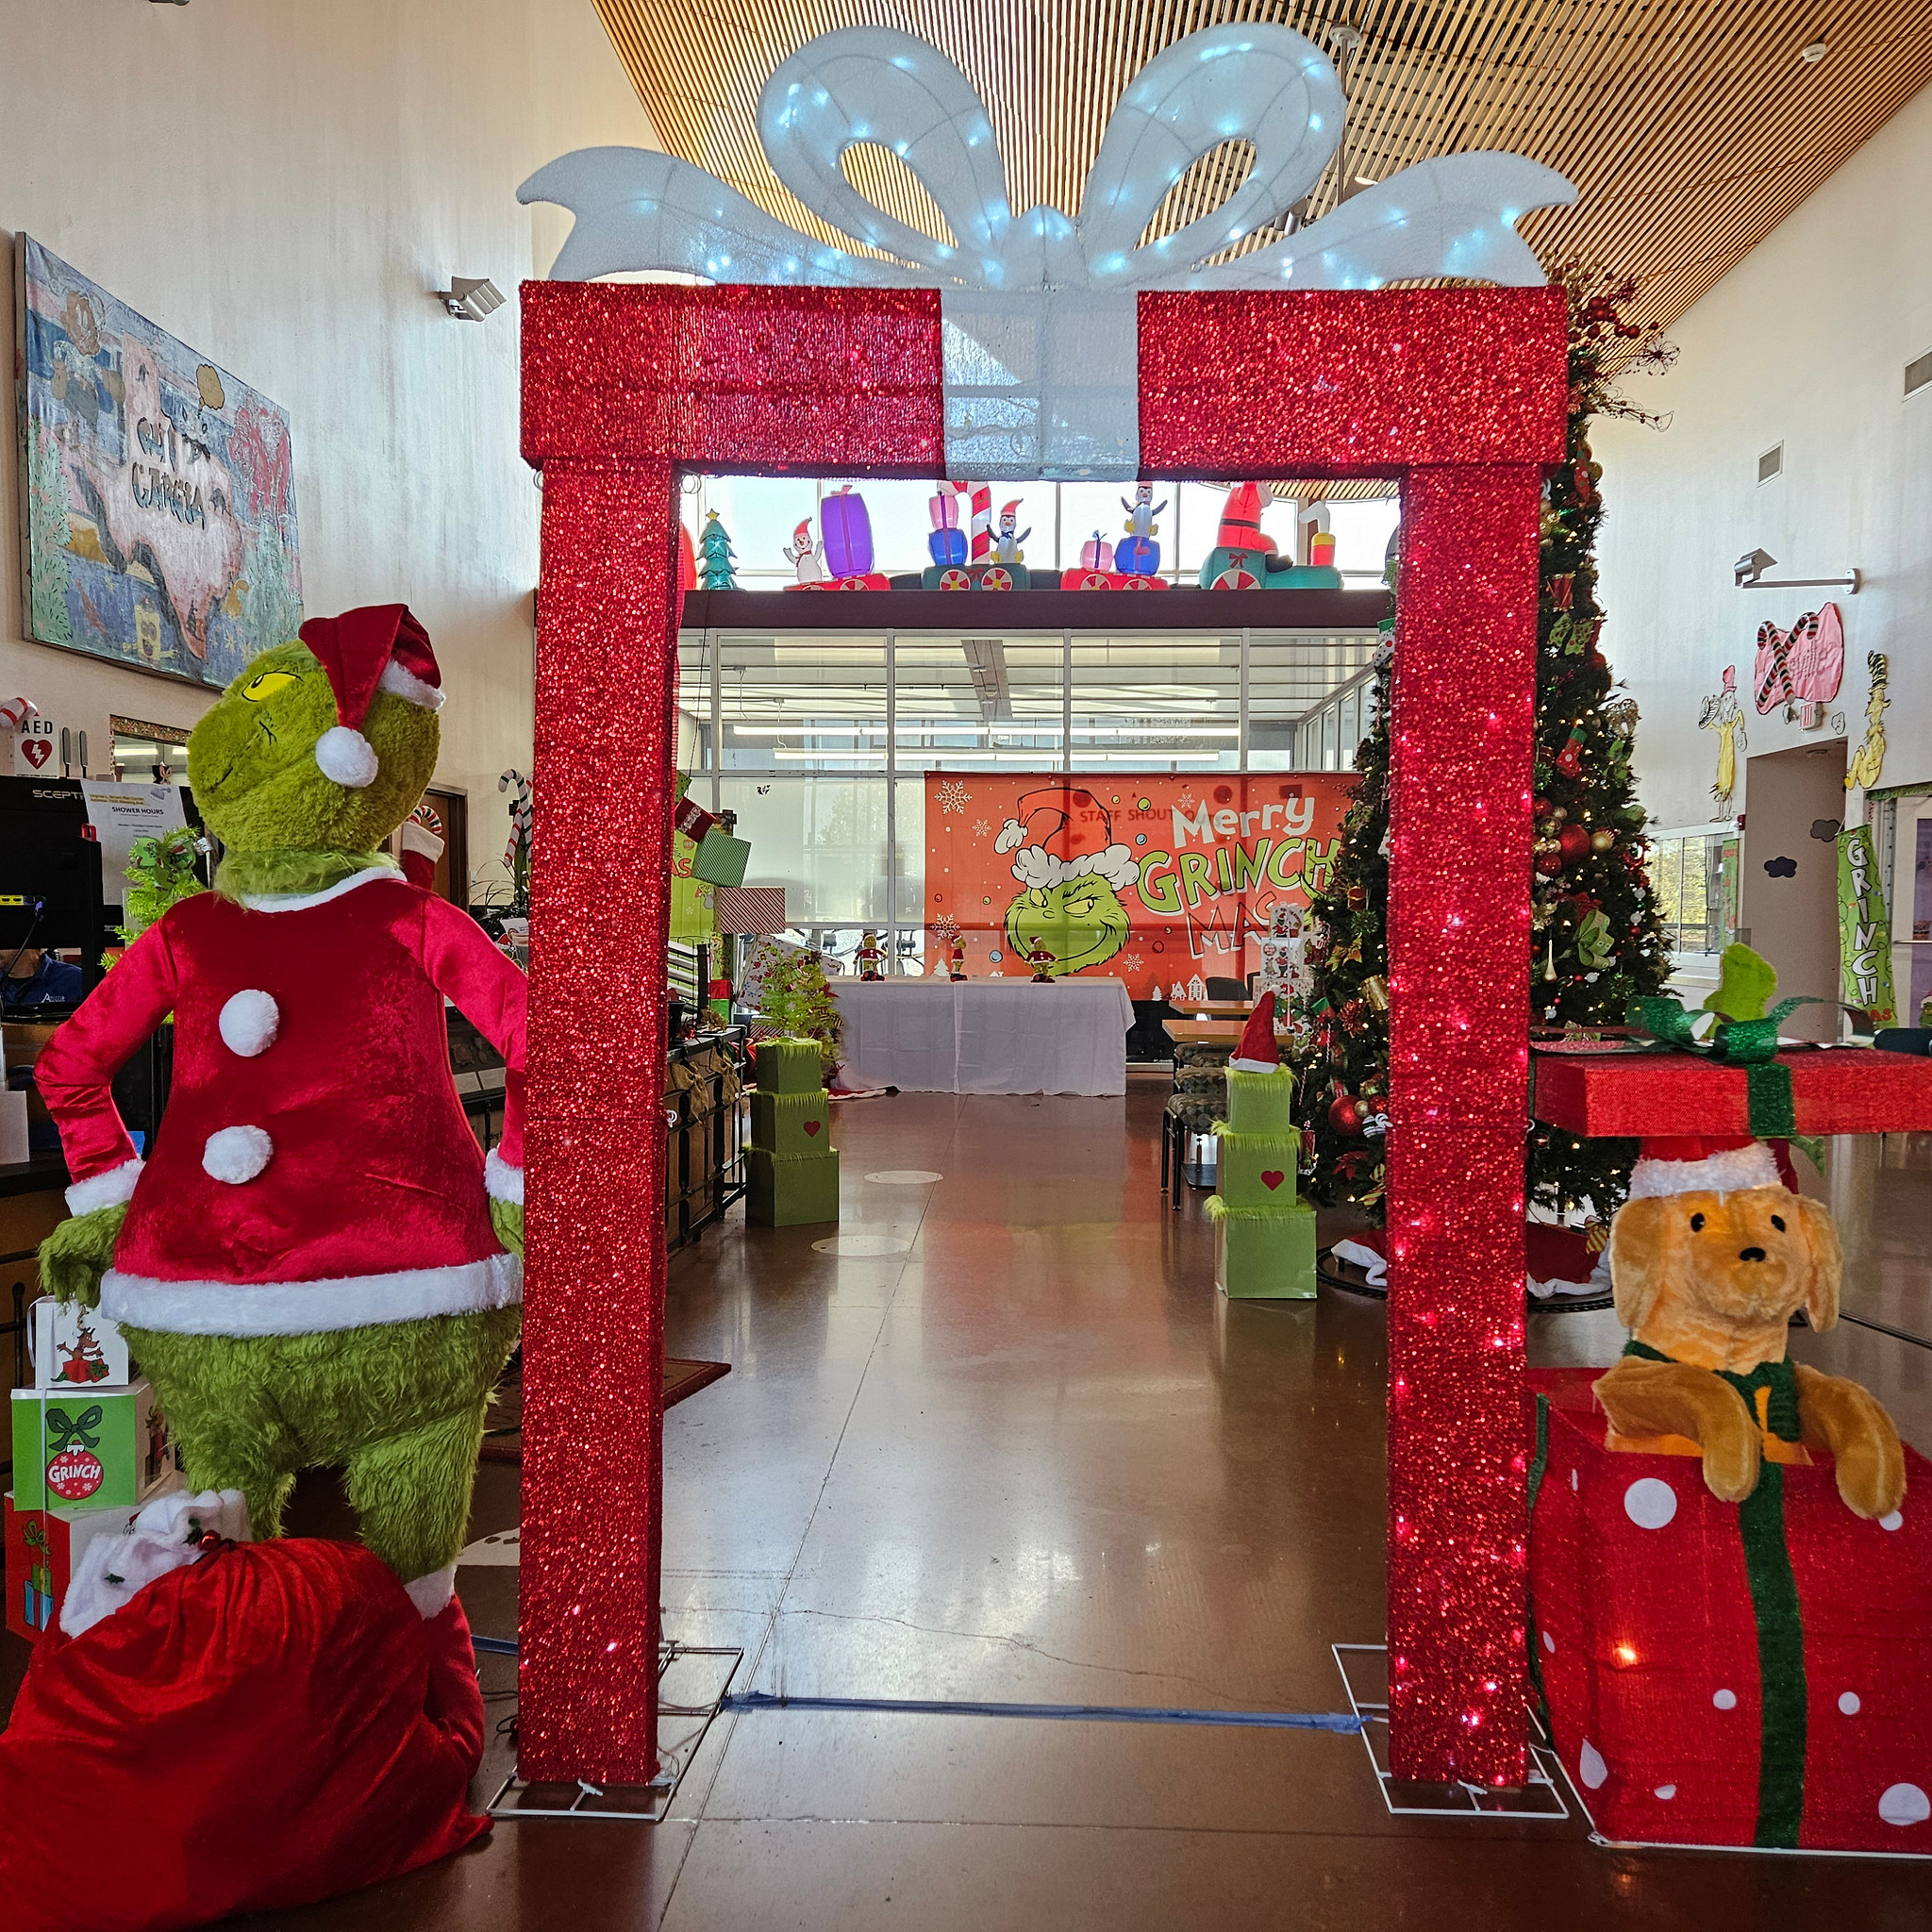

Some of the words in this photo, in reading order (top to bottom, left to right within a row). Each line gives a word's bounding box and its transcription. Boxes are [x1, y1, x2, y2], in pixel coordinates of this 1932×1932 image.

[21, 720, 53, 734] AED
[1080, 809, 1122, 823] STAFF
[1172, 796, 1315, 849] Merry
[1137, 836, 1341, 916] GRINCH
[1847, 838, 1879, 1007] GRINCH
[49, 1464, 101, 1483] GRINCH
